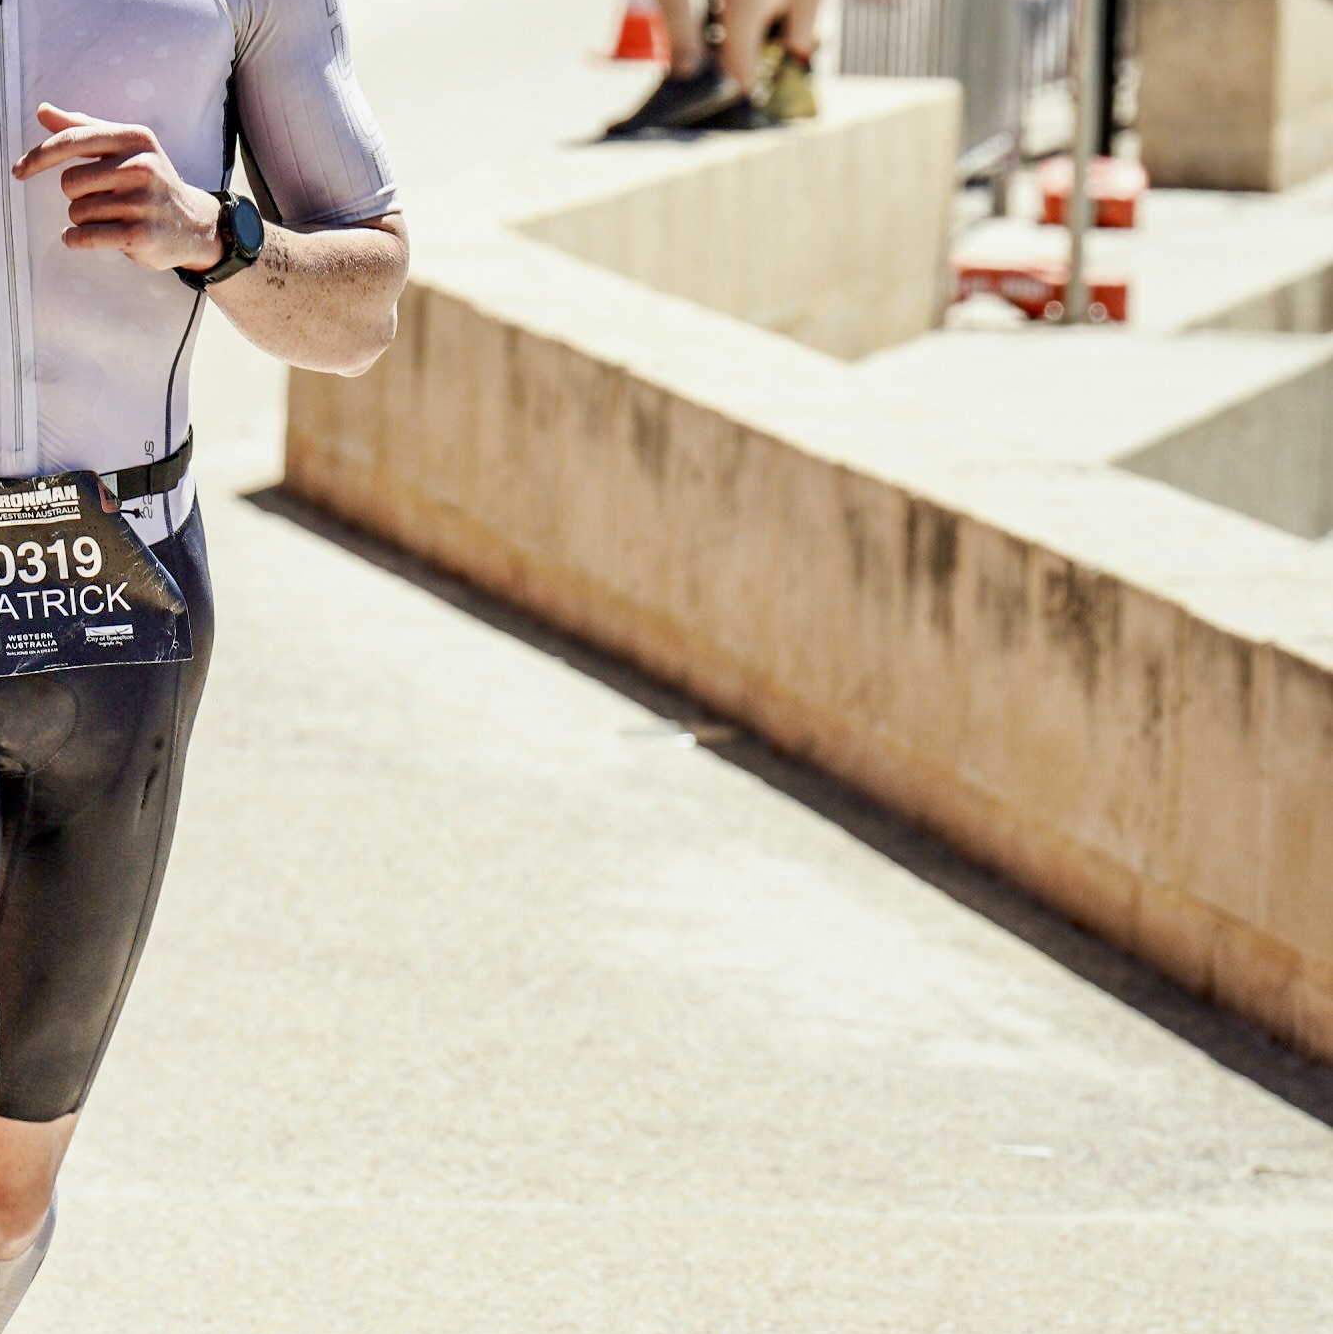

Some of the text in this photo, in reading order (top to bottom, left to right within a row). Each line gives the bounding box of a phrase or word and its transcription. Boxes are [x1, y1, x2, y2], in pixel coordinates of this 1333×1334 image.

[35, 506, 81, 520] AUSTRALIA
[7, 632, 54, 642] WESTERN
[5, 640, 58, 651] AUSTRALIA
